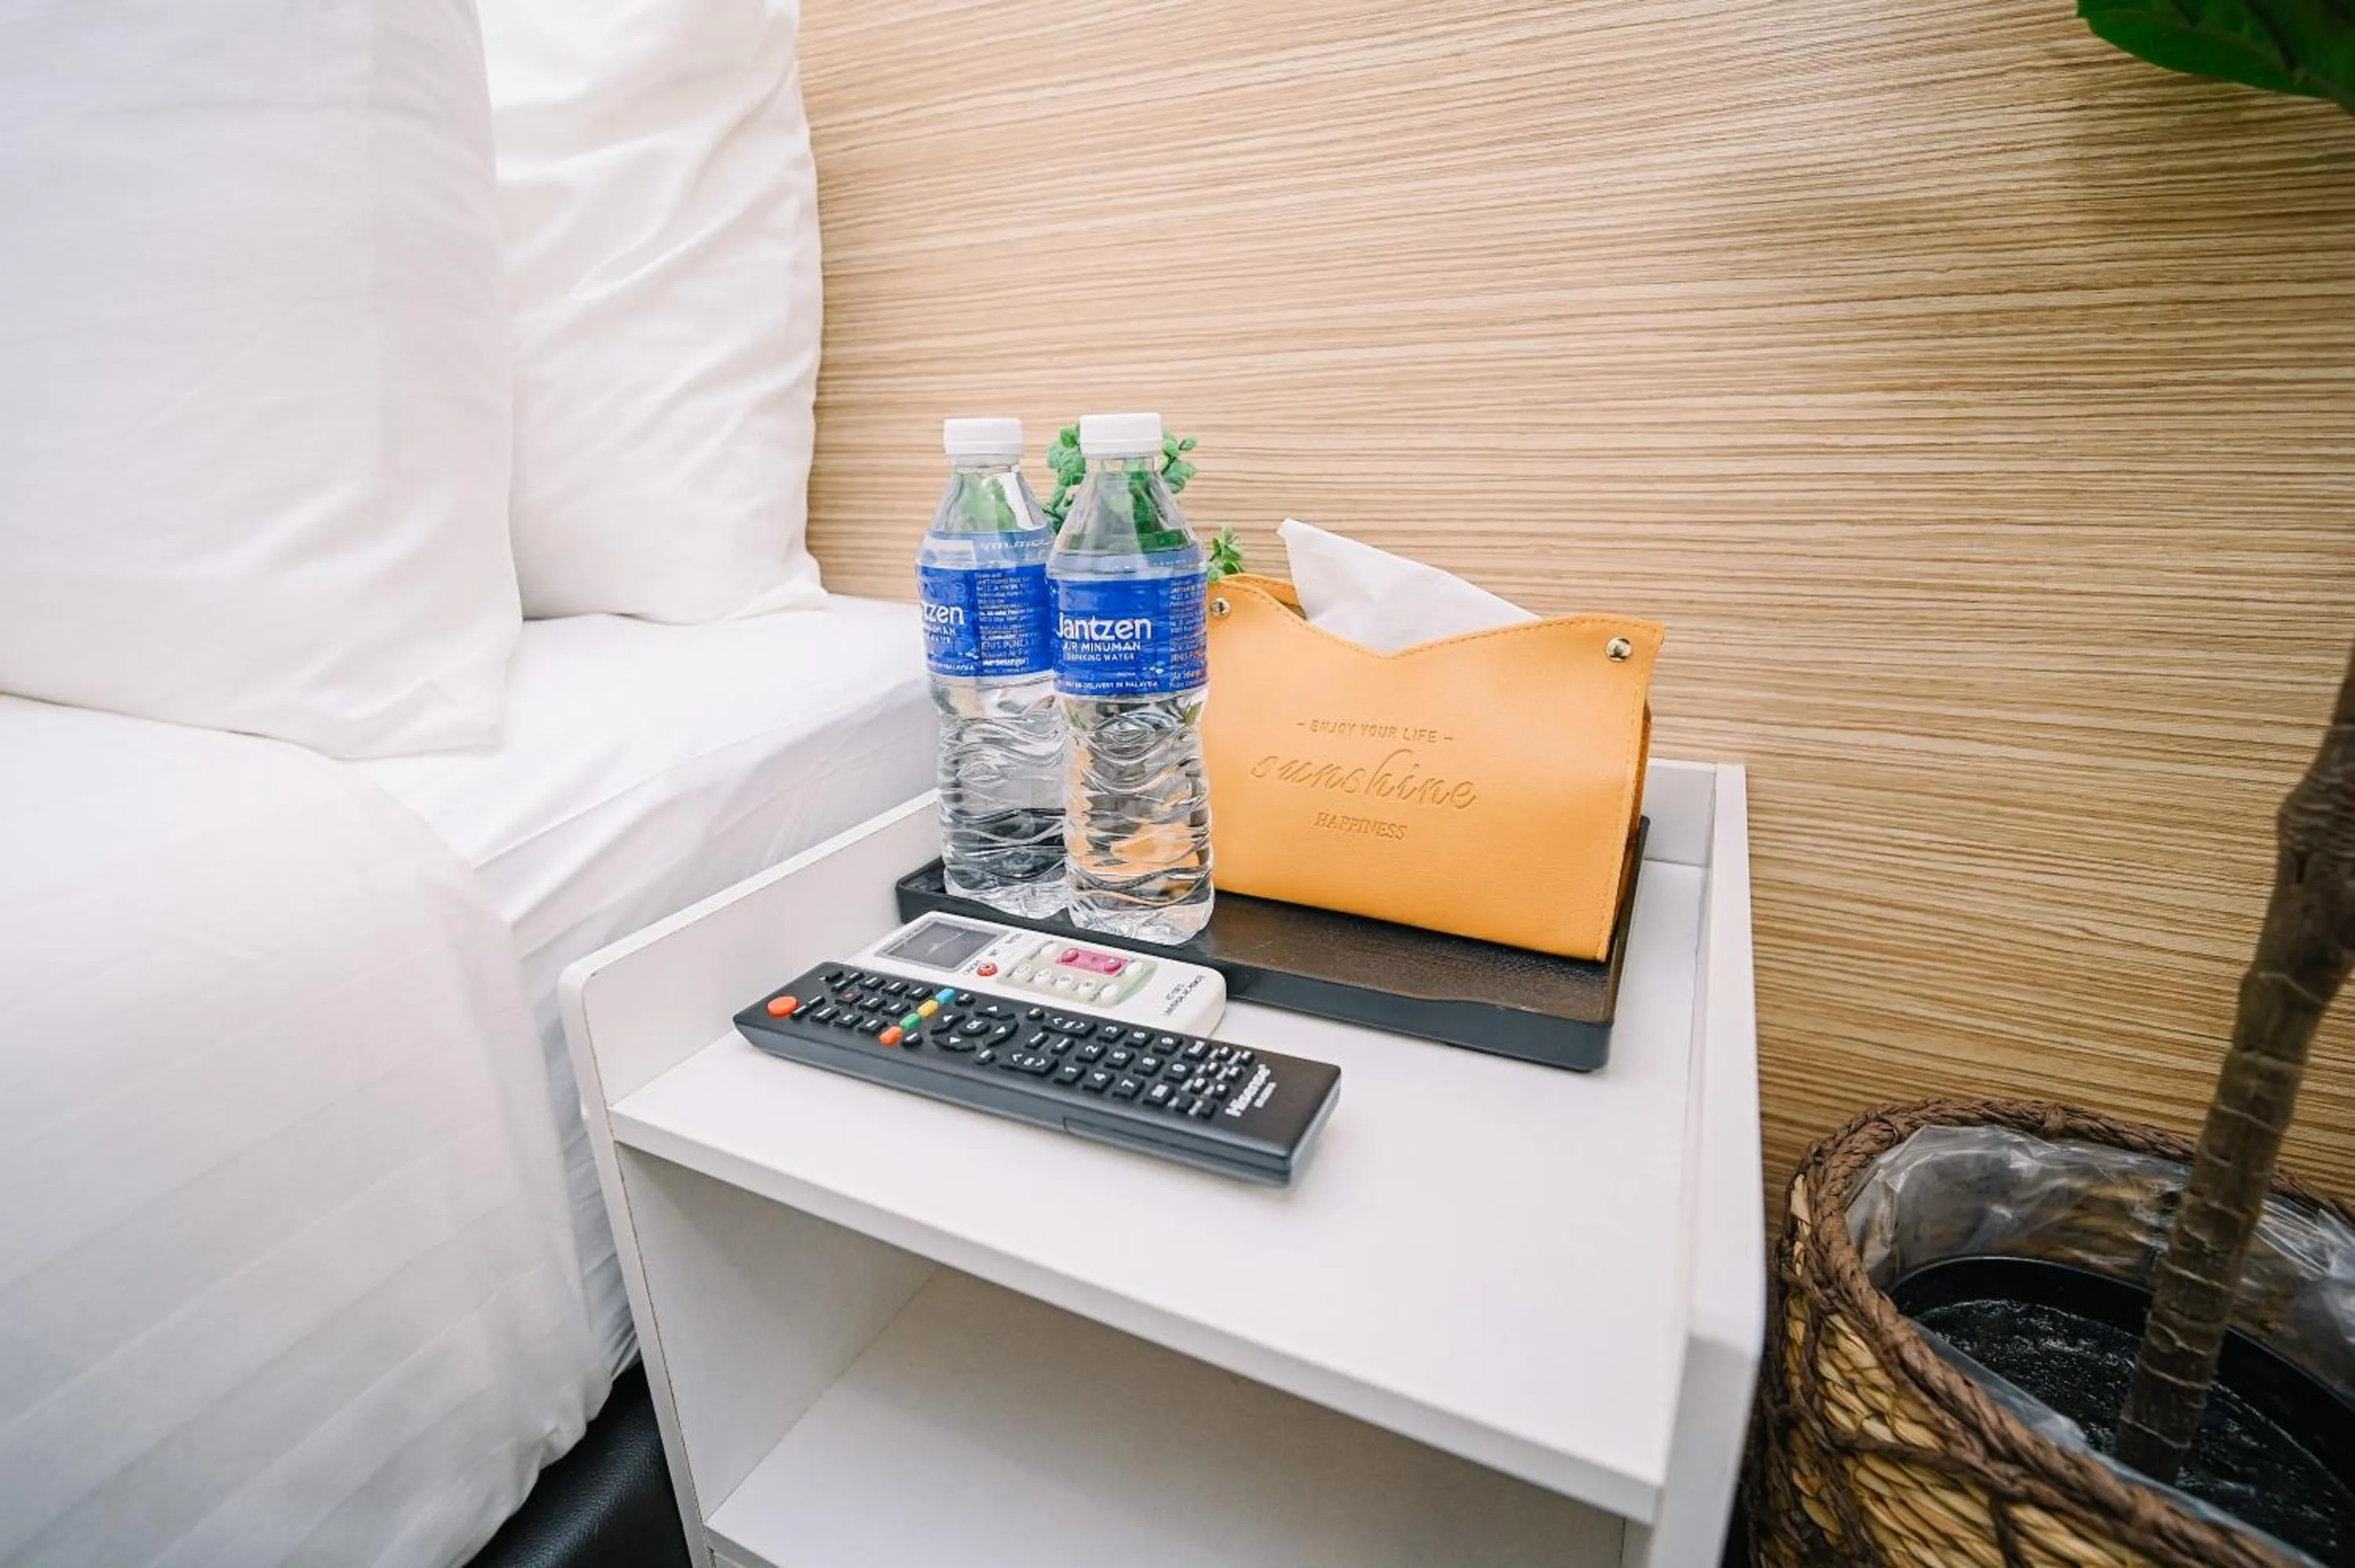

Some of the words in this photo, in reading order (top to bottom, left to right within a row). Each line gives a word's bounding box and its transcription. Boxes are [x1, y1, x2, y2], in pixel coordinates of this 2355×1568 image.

[921, 603, 965, 625] tzen
[1056, 612, 1152, 640] Jantzen
[1081, 641, 1141, 652] MINUMAN
[1103, 652, 1134, 661] WATER
[1309, 719, 1356, 736] ENJOY
[1360, 724, 1397, 740] YOUR
[1402, 727, 1438, 744] LIFE
[1251, 748, 1477, 809] sunshine
[1313, 811, 1408, 841] HAPPINESS
[1085, 1045, 1098, 1054] 2
[1112, 1051, 1126, 1059] 5
[1094, 1073, 1106, 1081] 4
[1121, 1079, 1134, 1088] 7
